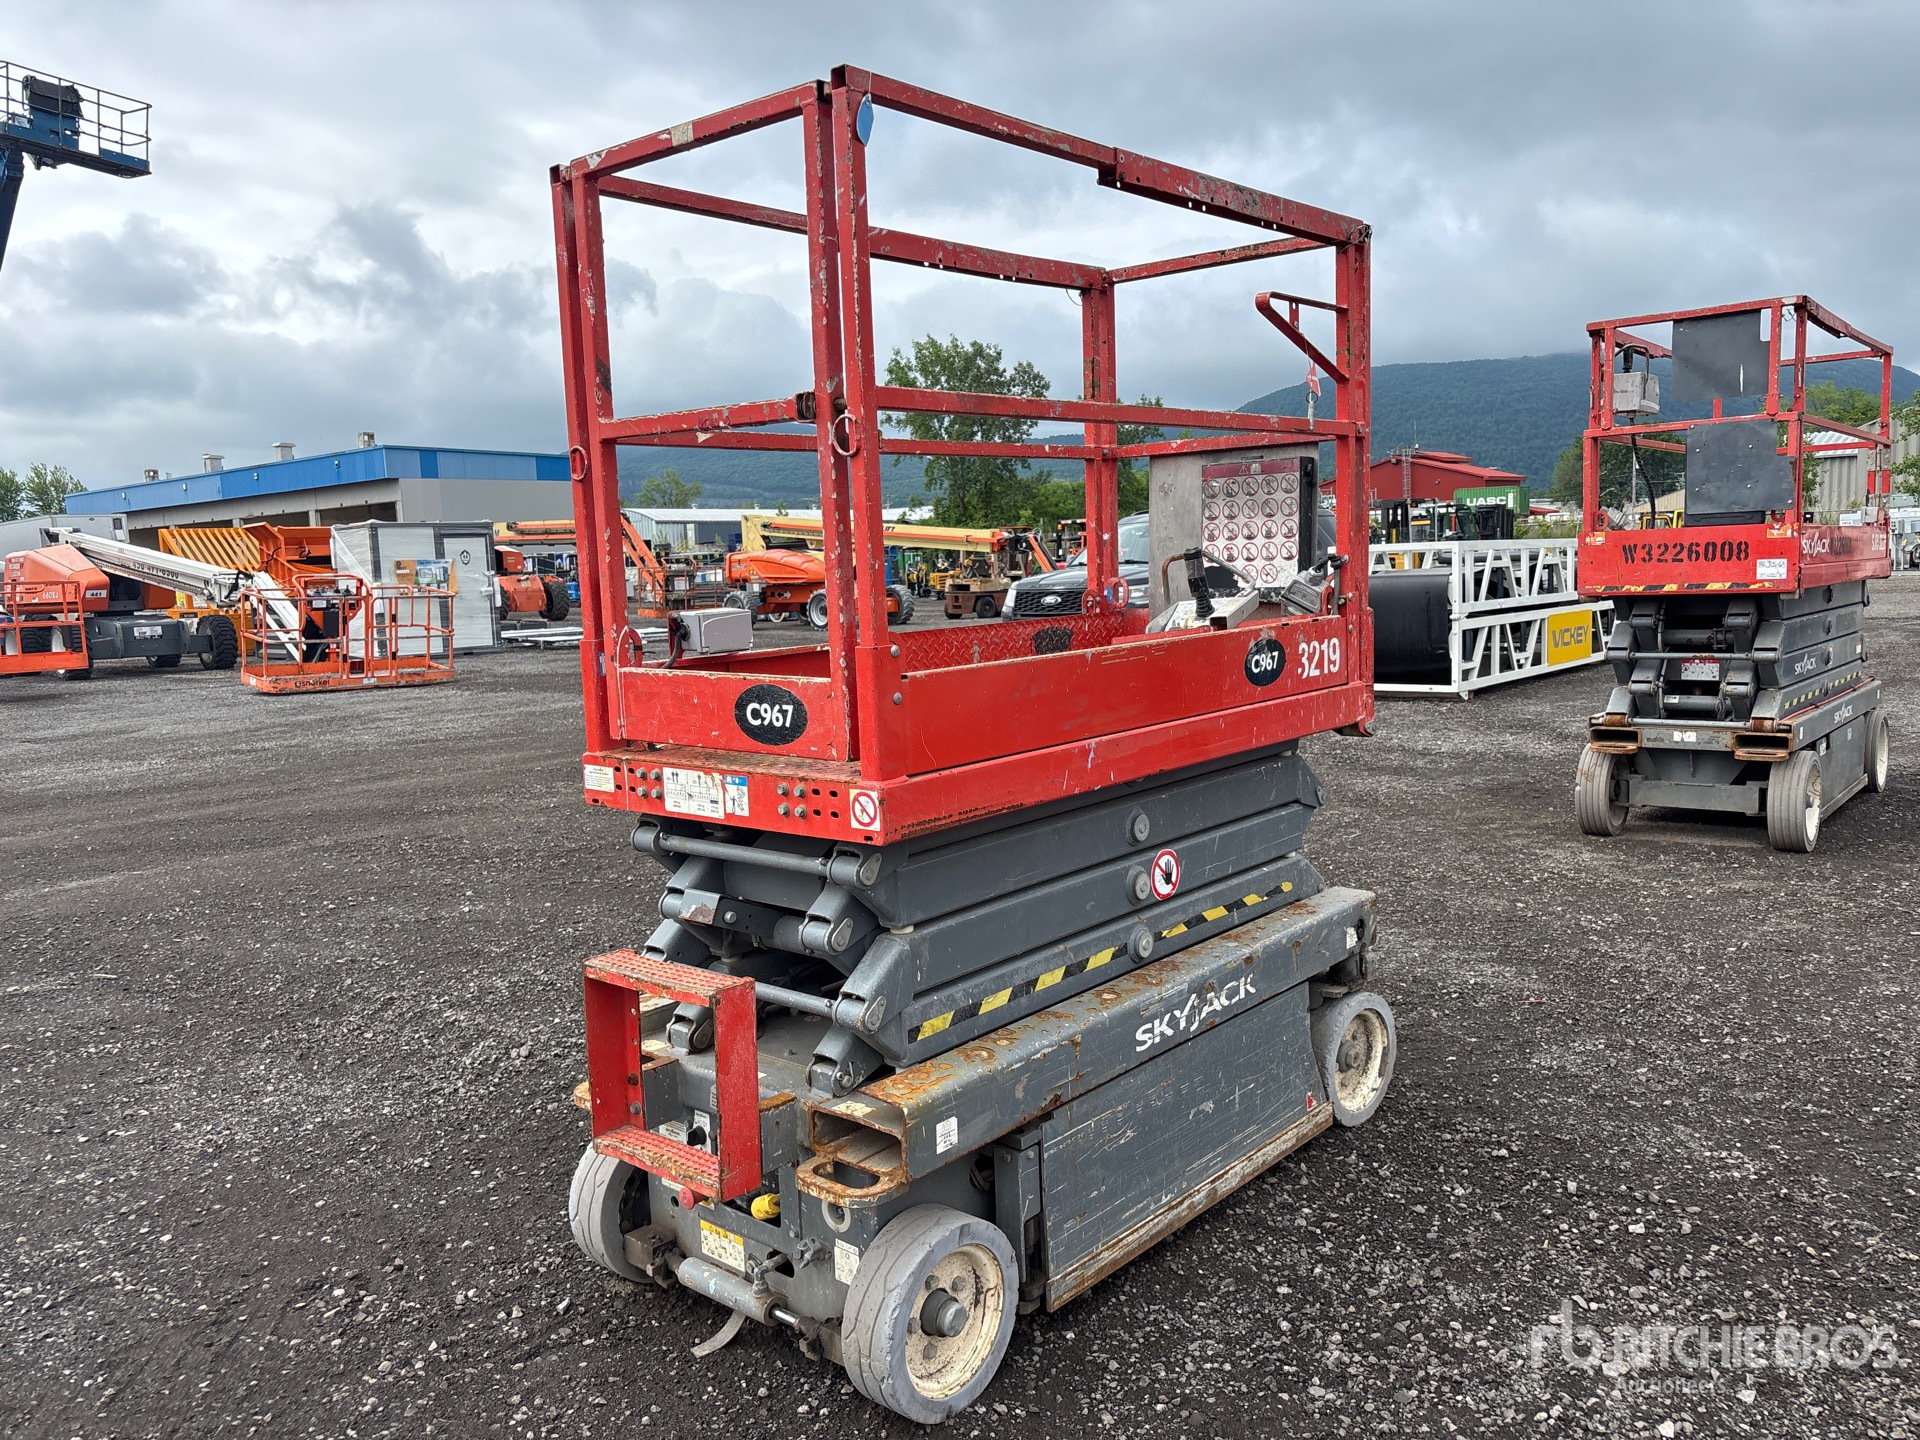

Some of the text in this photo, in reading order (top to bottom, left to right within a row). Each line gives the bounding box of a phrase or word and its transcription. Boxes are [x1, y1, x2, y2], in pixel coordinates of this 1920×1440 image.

[1466, 496, 1507, 506] UASC
[1621, 540, 1750, 564] W3226008
[1802, 532, 1830, 557] SKYJACK
[1551, 625, 1589, 649] VICKEY
[1251, 650, 1279, 674] C967
[1297, 637, 1341, 680] 3219
[1794, 652, 1817, 675] SKYJACK
[746, 702, 794, 728] C967
[1834, 702, 1853, 723] SKYJACK
[1135, 972, 1257, 1053] SKYJACK
